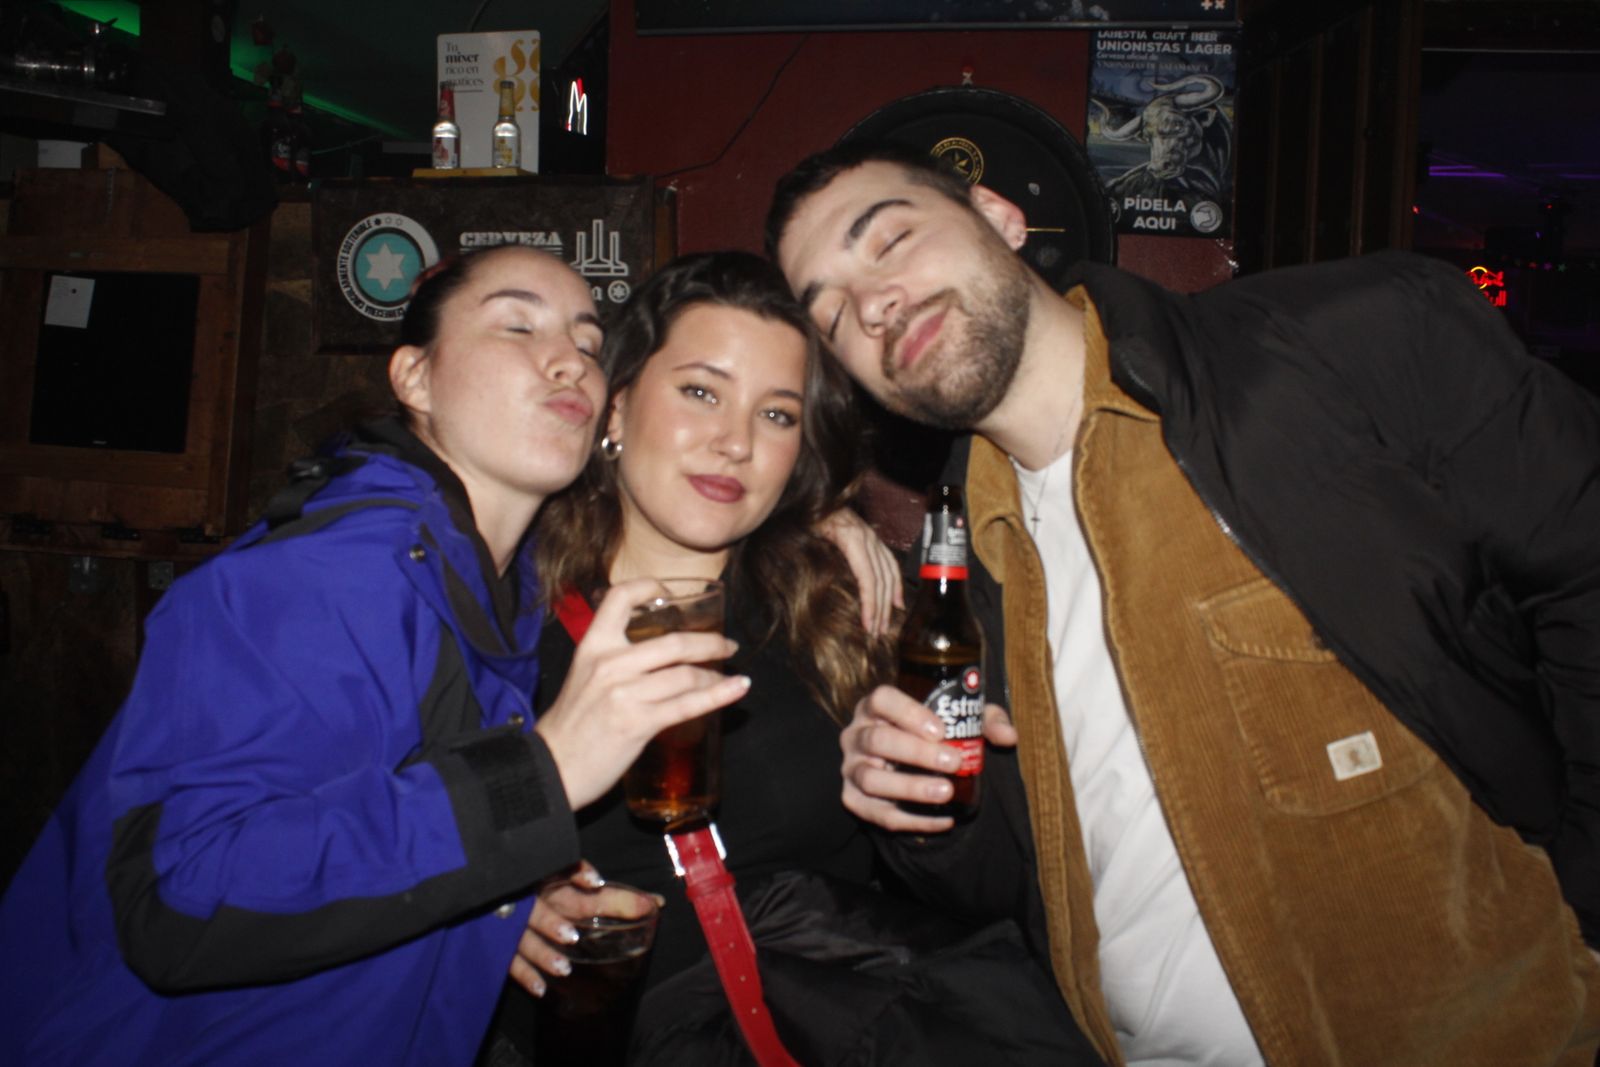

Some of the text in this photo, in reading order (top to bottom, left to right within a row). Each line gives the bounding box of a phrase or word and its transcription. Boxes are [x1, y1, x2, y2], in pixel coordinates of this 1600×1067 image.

[1096, 41, 1232, 55] UNIONISTAS LAGER
[445, 52, 479, 64] mixer
[1123, 194, 1187, 213] PÍDELA
[459, 231, 563, 247] CERVEZA
